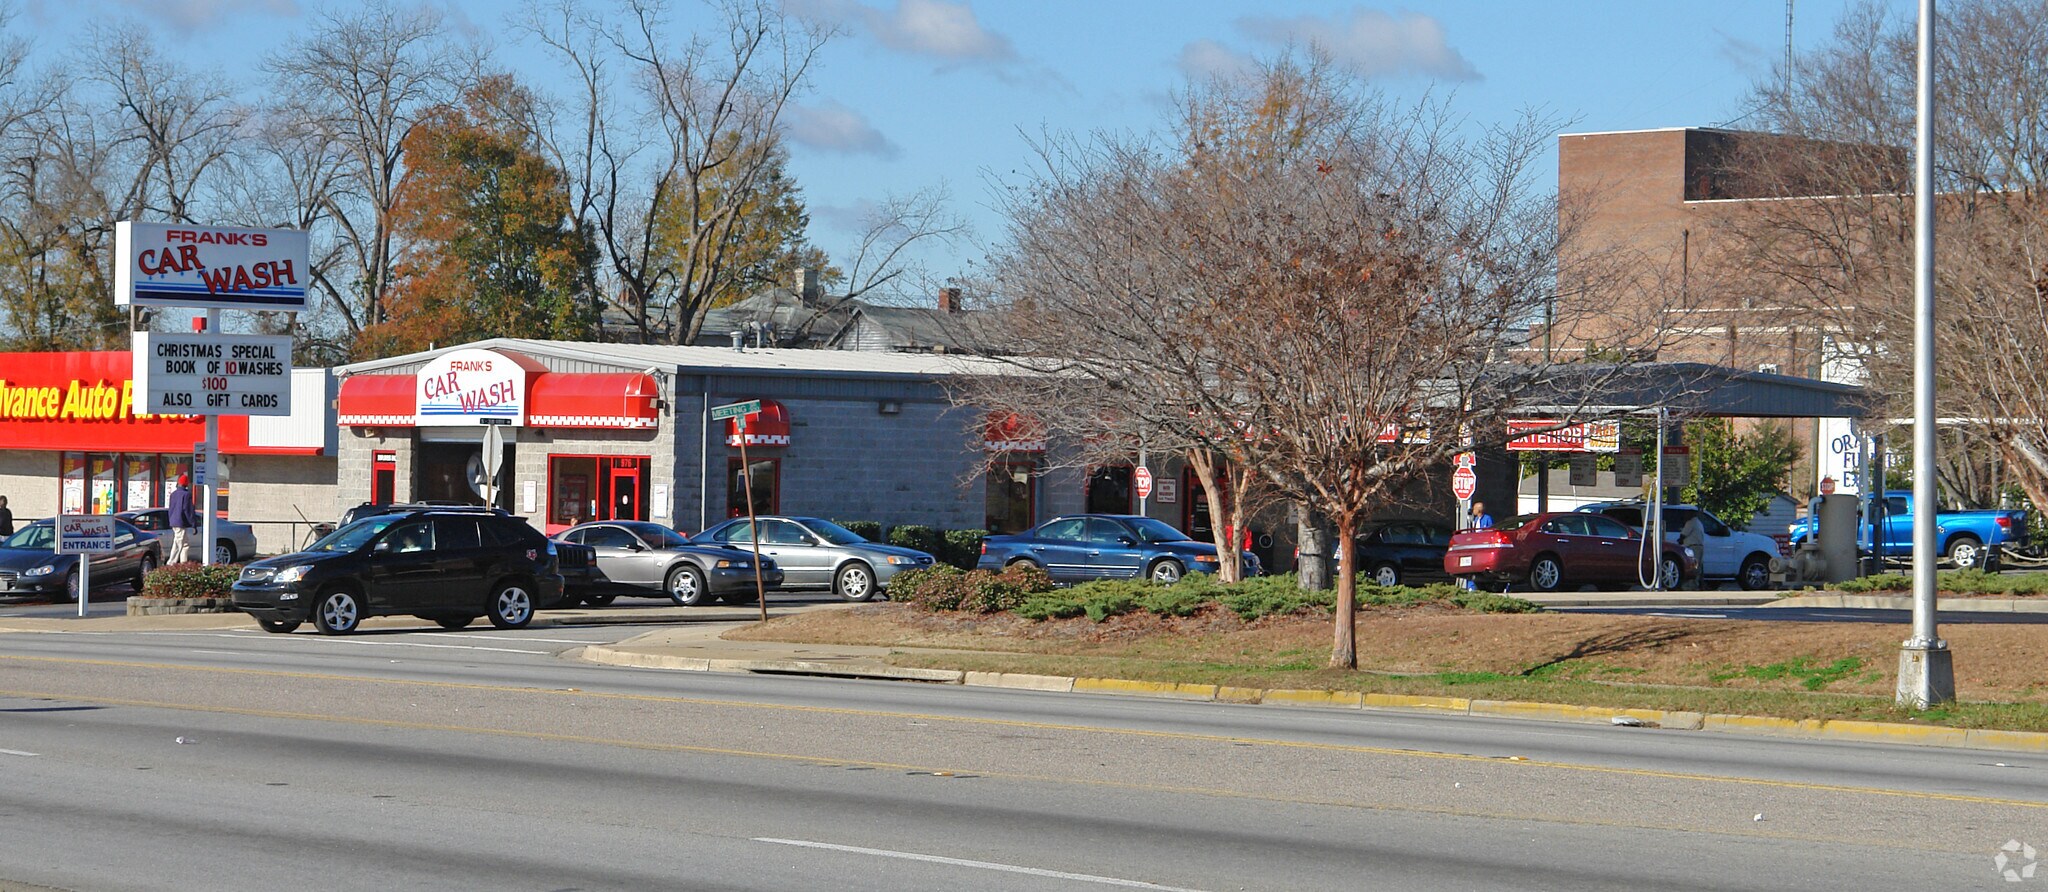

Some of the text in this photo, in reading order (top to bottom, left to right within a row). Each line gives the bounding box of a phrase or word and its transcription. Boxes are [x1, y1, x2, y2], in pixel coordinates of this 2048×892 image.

[167, 230, 267, 246] FRANK'S
[138, 244, 206, 276] CAR
[200, 259, 298, 295] WASH
[157, 343, 276, 359] CHRISTMAS SPECIAL
[166, 360, 283, 375] BOOK OF 10 WASHES
[202, 377, 228, 391] $100
[424, 371, 461, 400] CAR
[0, 379, 60, 418] vance
[60, 378, 118, 419] Auto
[163, 393, 278, 408] ALSO GIFT CARDS
[458, 379, 517, 415] WASH
[712, 404, 747, 419] MEETING
[621, 458, 632, 468] 976
[1455, 477, 1474, 490] STOP
[1821, 482, 1835, 491] STOP
[64, 522, 82, 532] CAR
[80, 525, 109, 536] WASH
[63, 540, 111, 550] ENTRANCE
